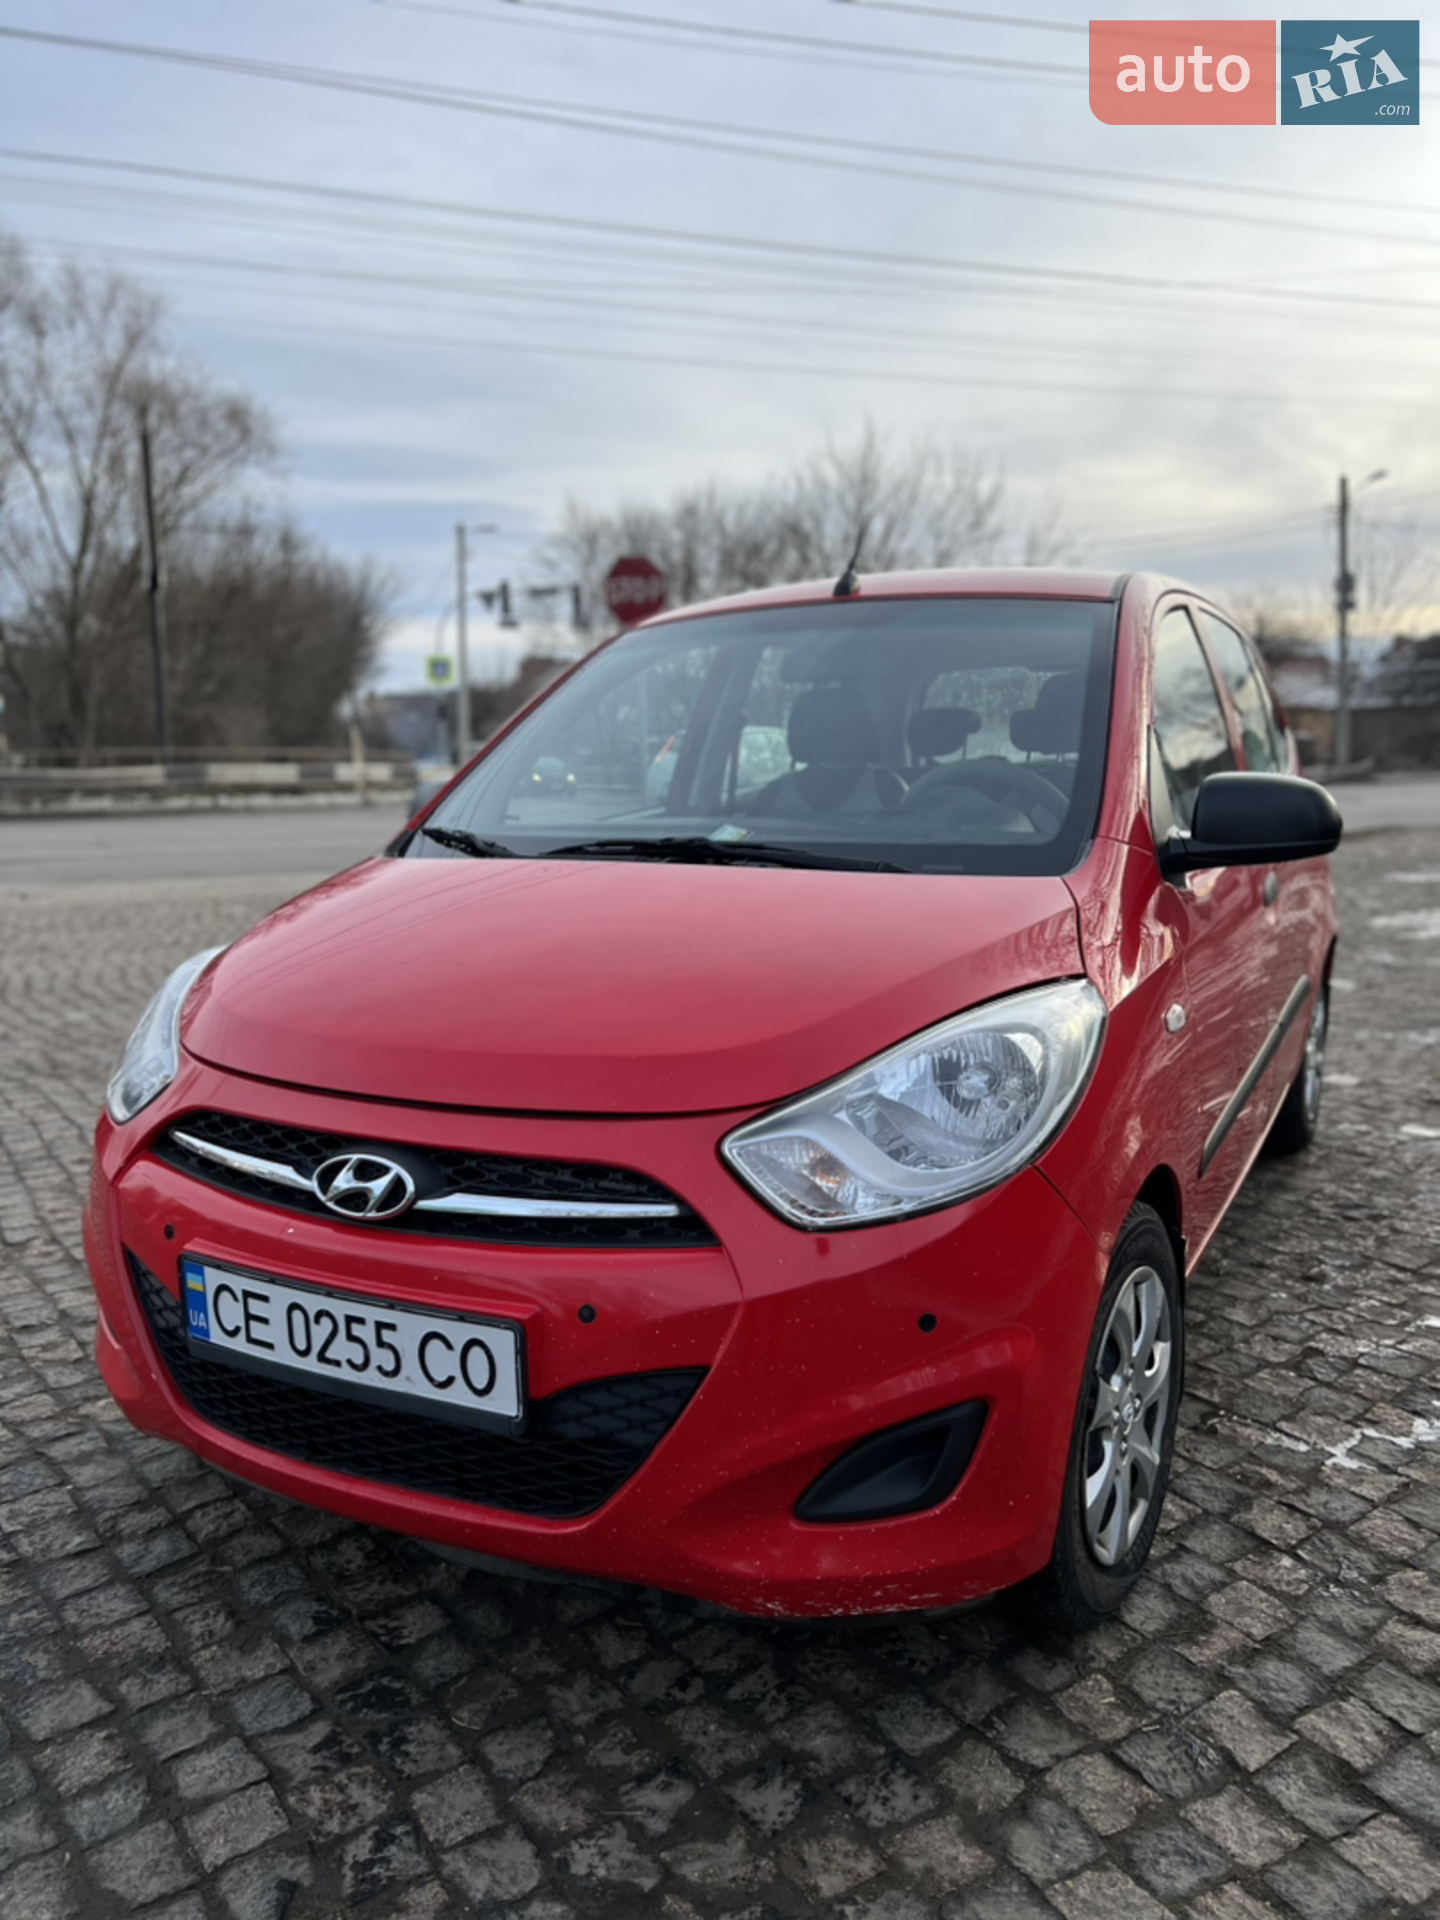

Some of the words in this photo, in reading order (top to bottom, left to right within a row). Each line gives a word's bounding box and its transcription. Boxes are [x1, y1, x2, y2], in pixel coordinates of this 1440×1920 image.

[189, 1308, 207, 1330] UA
[212, 1283, 275, 1351] CE
[286, 1301, 402, 1378] 0255
[418, 1331, 497, 1398] CO
